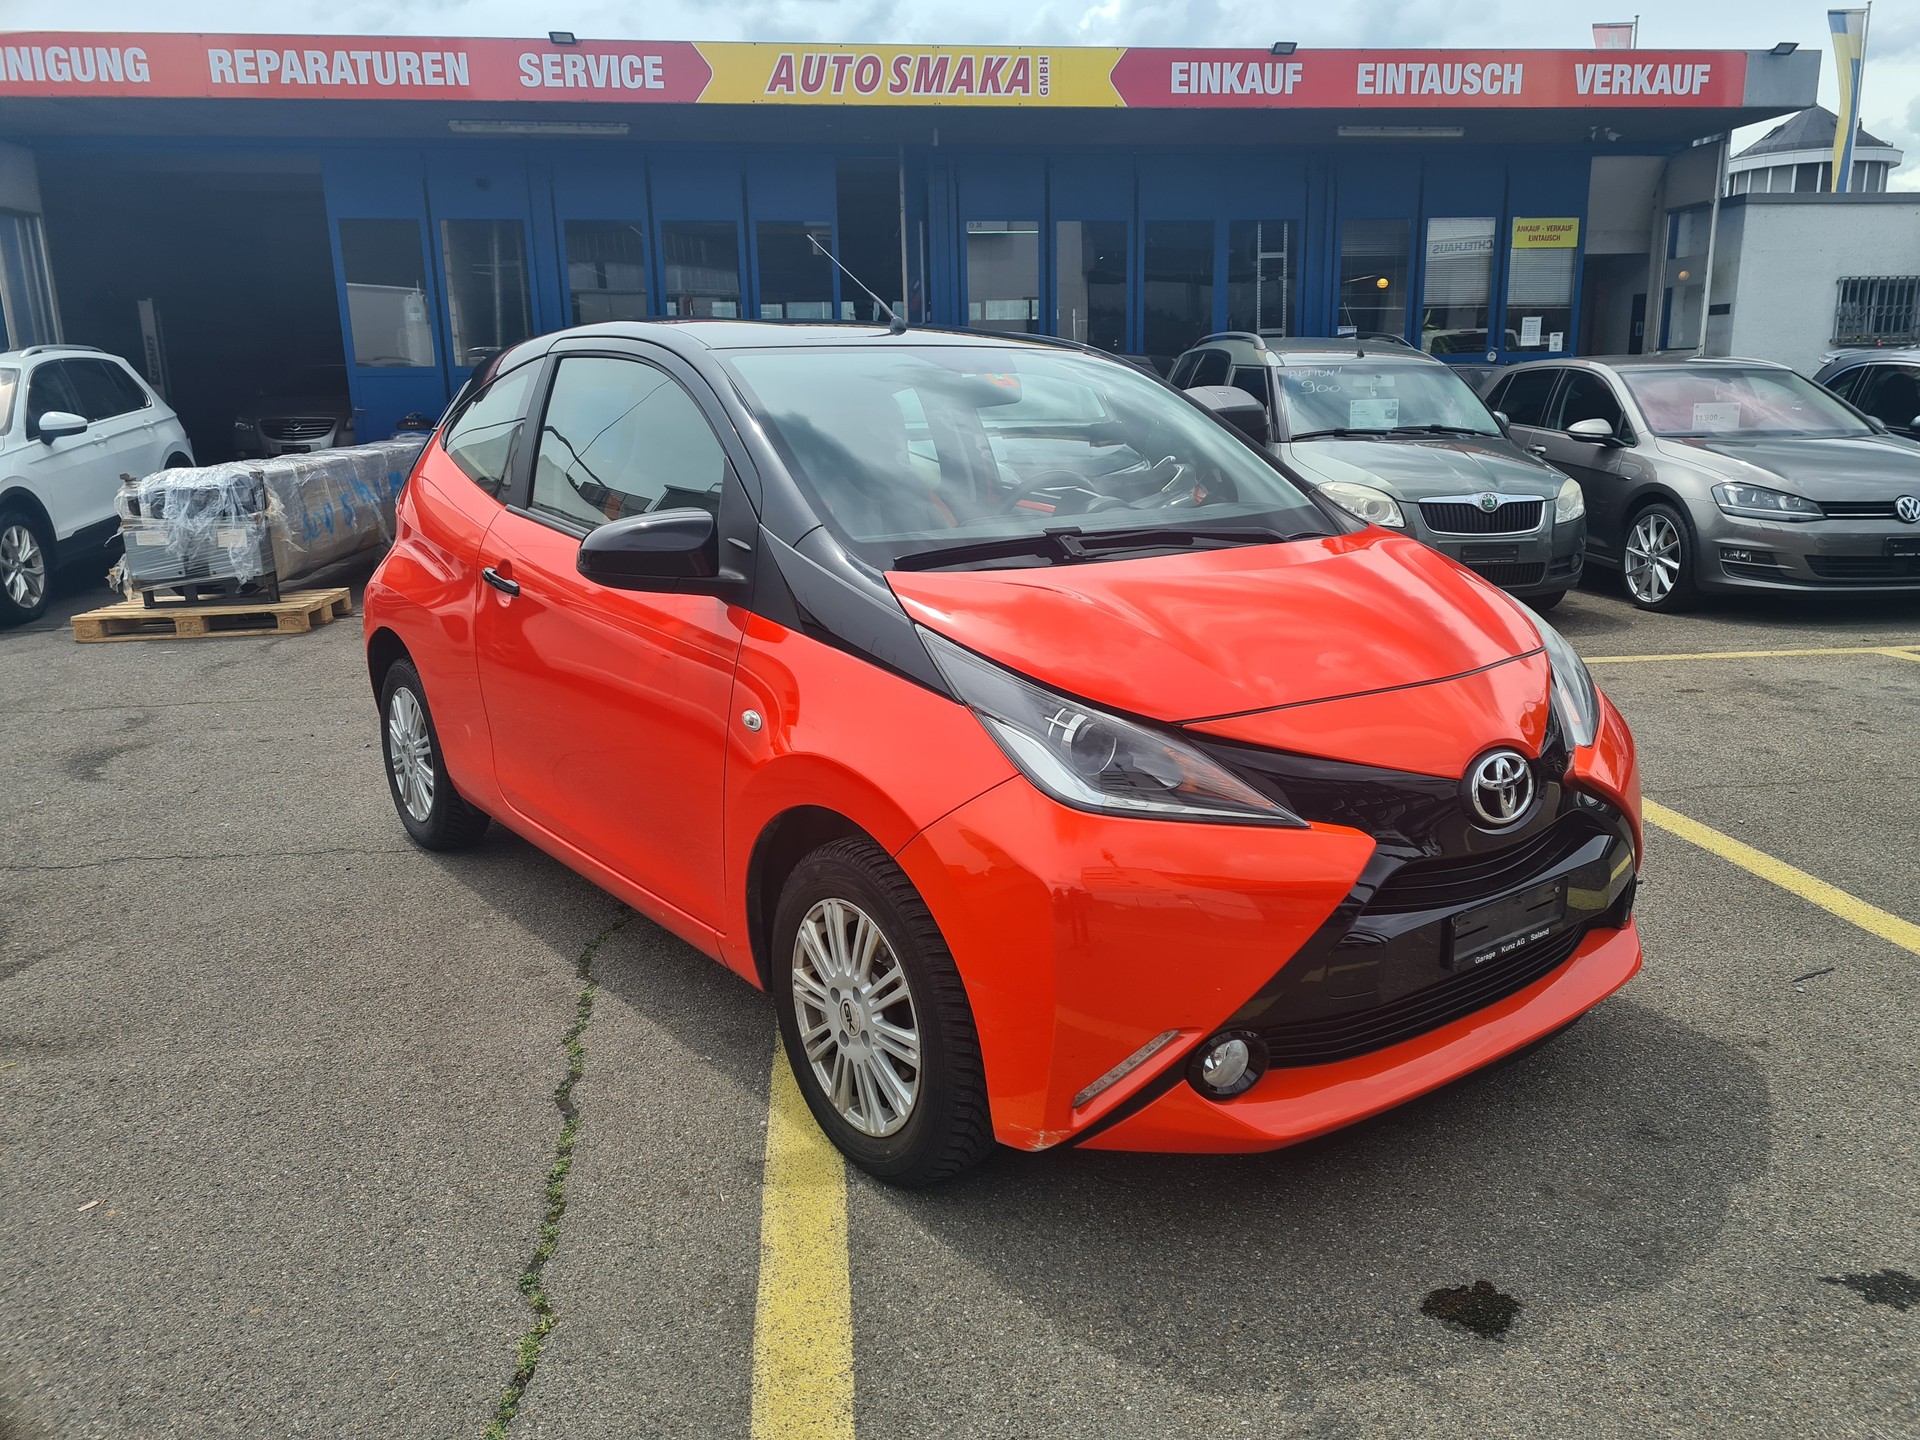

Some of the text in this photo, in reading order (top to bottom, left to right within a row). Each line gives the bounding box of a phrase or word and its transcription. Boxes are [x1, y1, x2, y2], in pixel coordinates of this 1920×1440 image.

[207, 48, 470, 87] REPARATUREN
[517, 52, 665, 90] SERVICE
[765, 53, 1033, 97] AUTO SMAKA
[1038, 56, 1050, 96] GMBH
[1170, 61, 1303, 96] EINKAUF
[1356, 62, 1524, 96] EINTAUSCH
[1574, 63, 1711, 96] VERKAUF
[1528, 234, 1561, 242] EINTAUSCH
[1475, 951, 1496, 964] Garage
[1501, 943, 1516, 953] Kunz
[1516, 938, 1526, 947] AG
